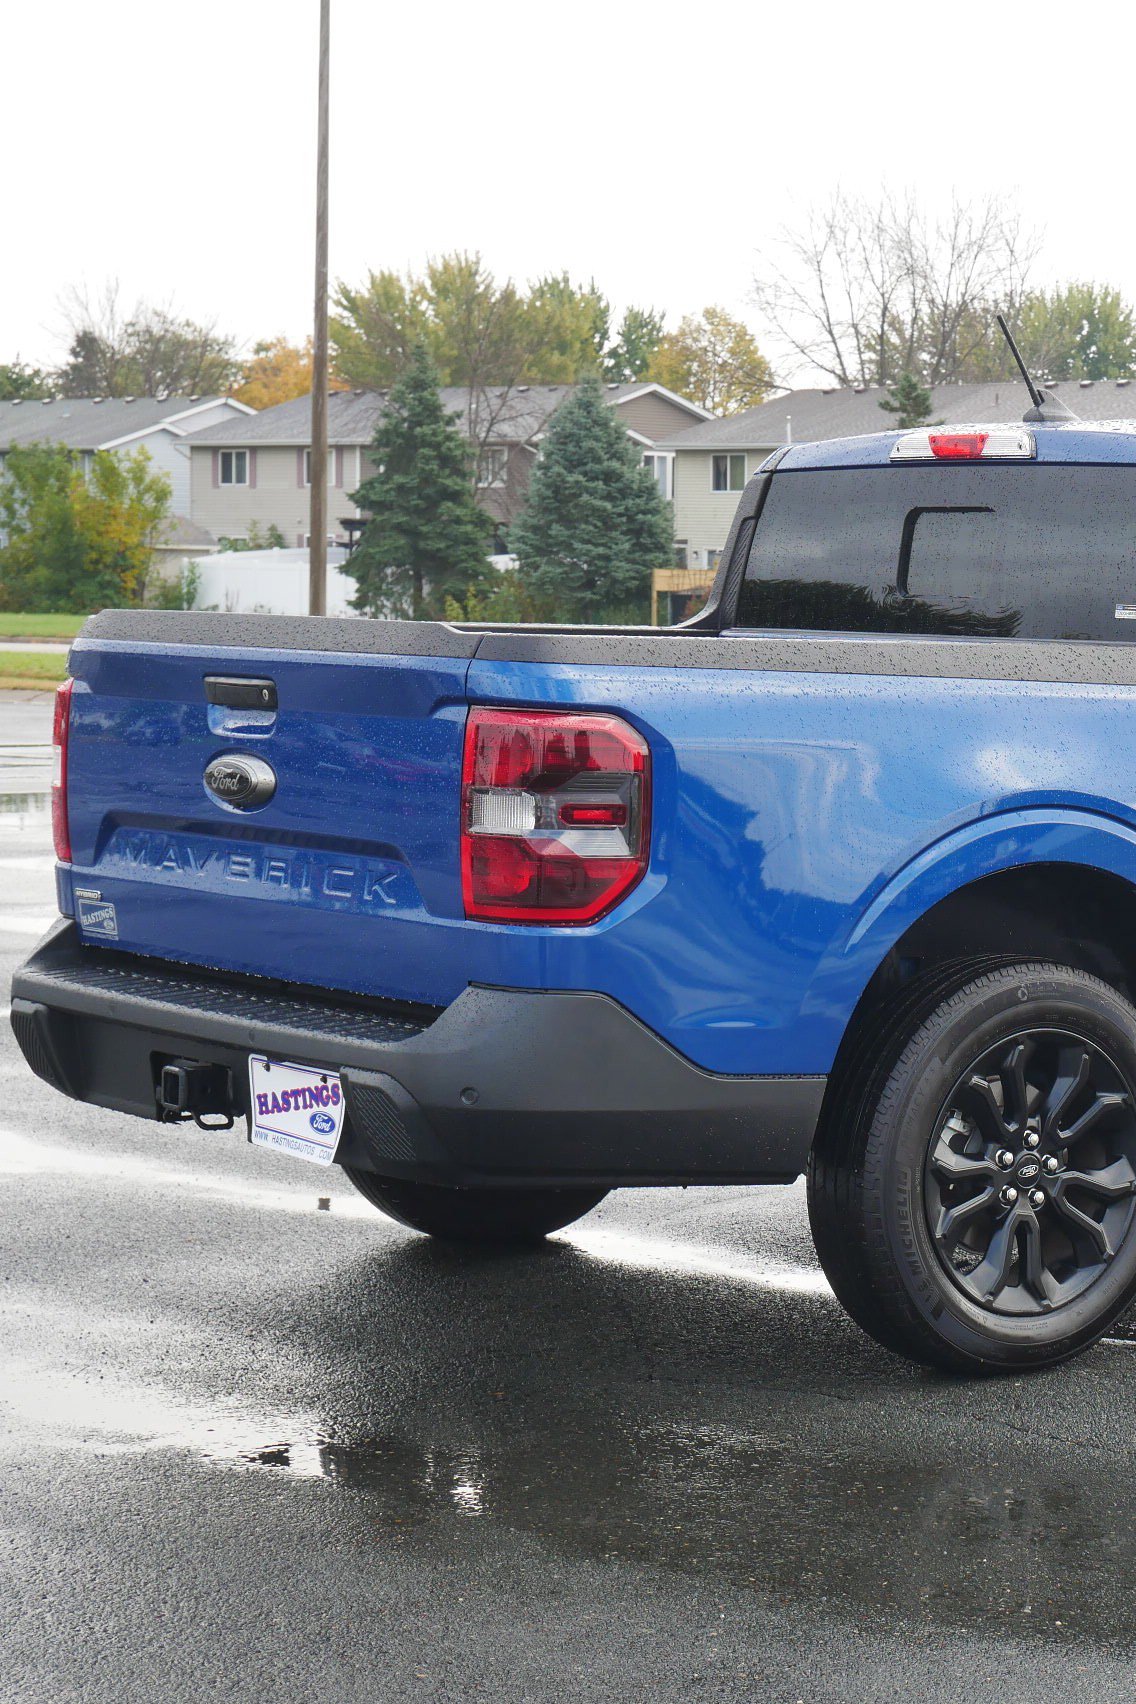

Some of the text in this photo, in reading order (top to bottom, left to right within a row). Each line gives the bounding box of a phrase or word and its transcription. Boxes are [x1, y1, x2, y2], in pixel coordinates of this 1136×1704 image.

[212, 766, 241, 791] Ford
[120, 845, 398, 904] MAVERICK
[81, 907, 114, 926] HASTINGS
[256, 1083, 341, 1115] HASTINGS
[312, 1114, 333, 1132] Ford
